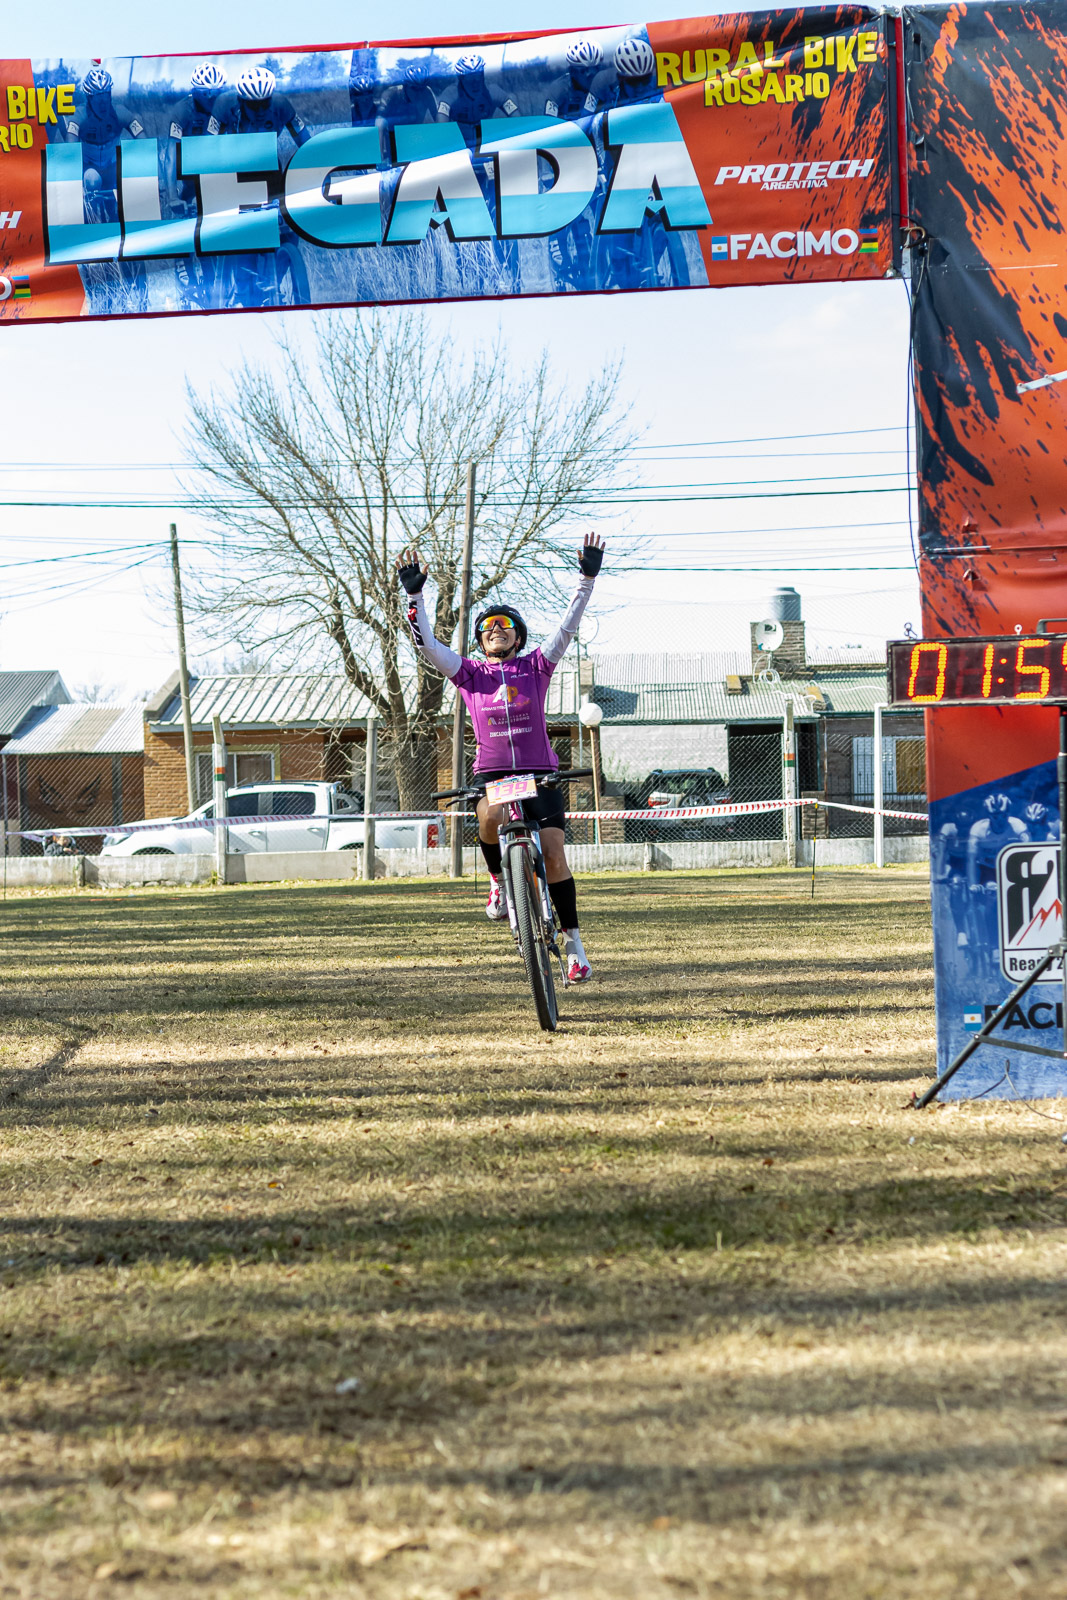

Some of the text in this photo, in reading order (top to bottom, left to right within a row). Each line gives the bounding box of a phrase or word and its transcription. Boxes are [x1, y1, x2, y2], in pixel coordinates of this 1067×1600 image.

[655, 31, 878, 87] RURAL BIKE
[7, 84, 76, 126] BIKE
[703, 71, 830, 107] ROSARIO
[42, 102, 713, 266] LLEGADA
[714, 158, 875, 185] PROTECH
[760, 178, 828, 191] ARGENTINA
[730, 228, 859, 260] FACIMO
[494, 781, 528, 798] 139
